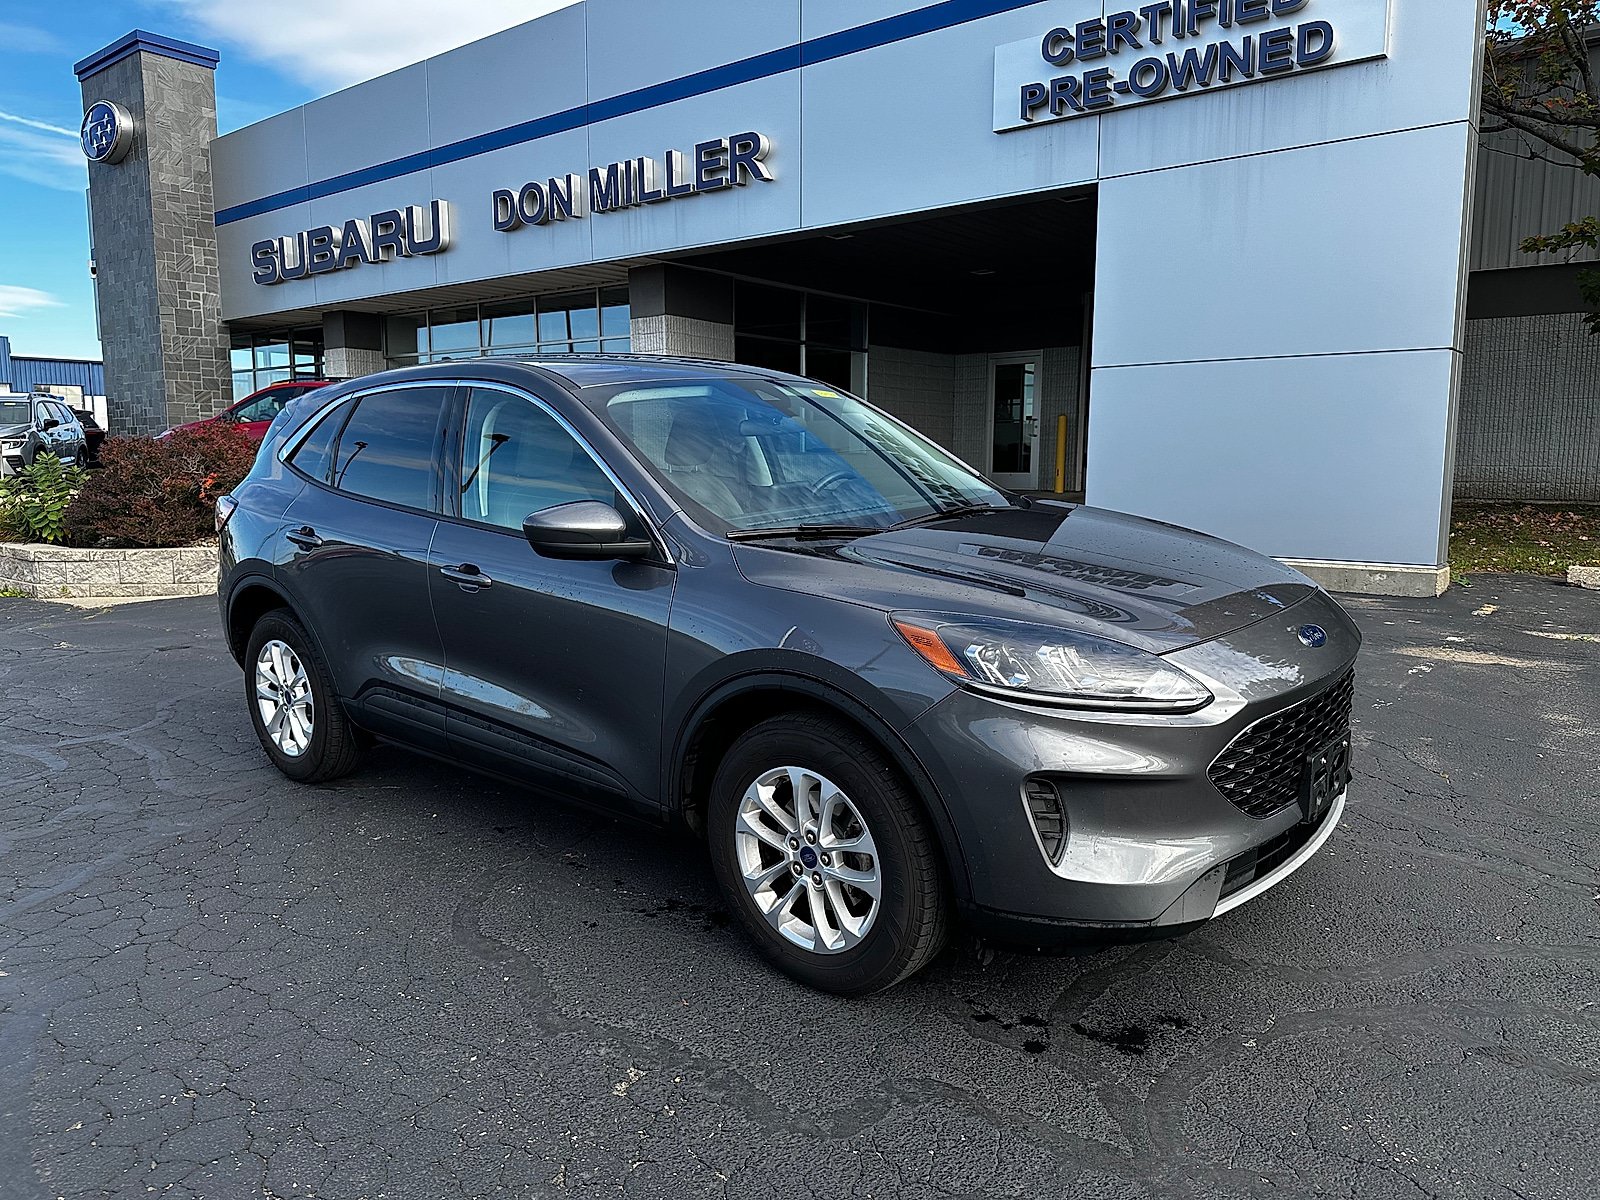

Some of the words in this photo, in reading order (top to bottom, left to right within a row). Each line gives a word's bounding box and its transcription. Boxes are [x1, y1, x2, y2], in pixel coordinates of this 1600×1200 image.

[1020, 20, 1334, 121] PRE-OWNED
[493, 173, 581, 231] DON
[588, 131, 772, 213] MILLER
[251, 199, 448, 285] SUBARU
